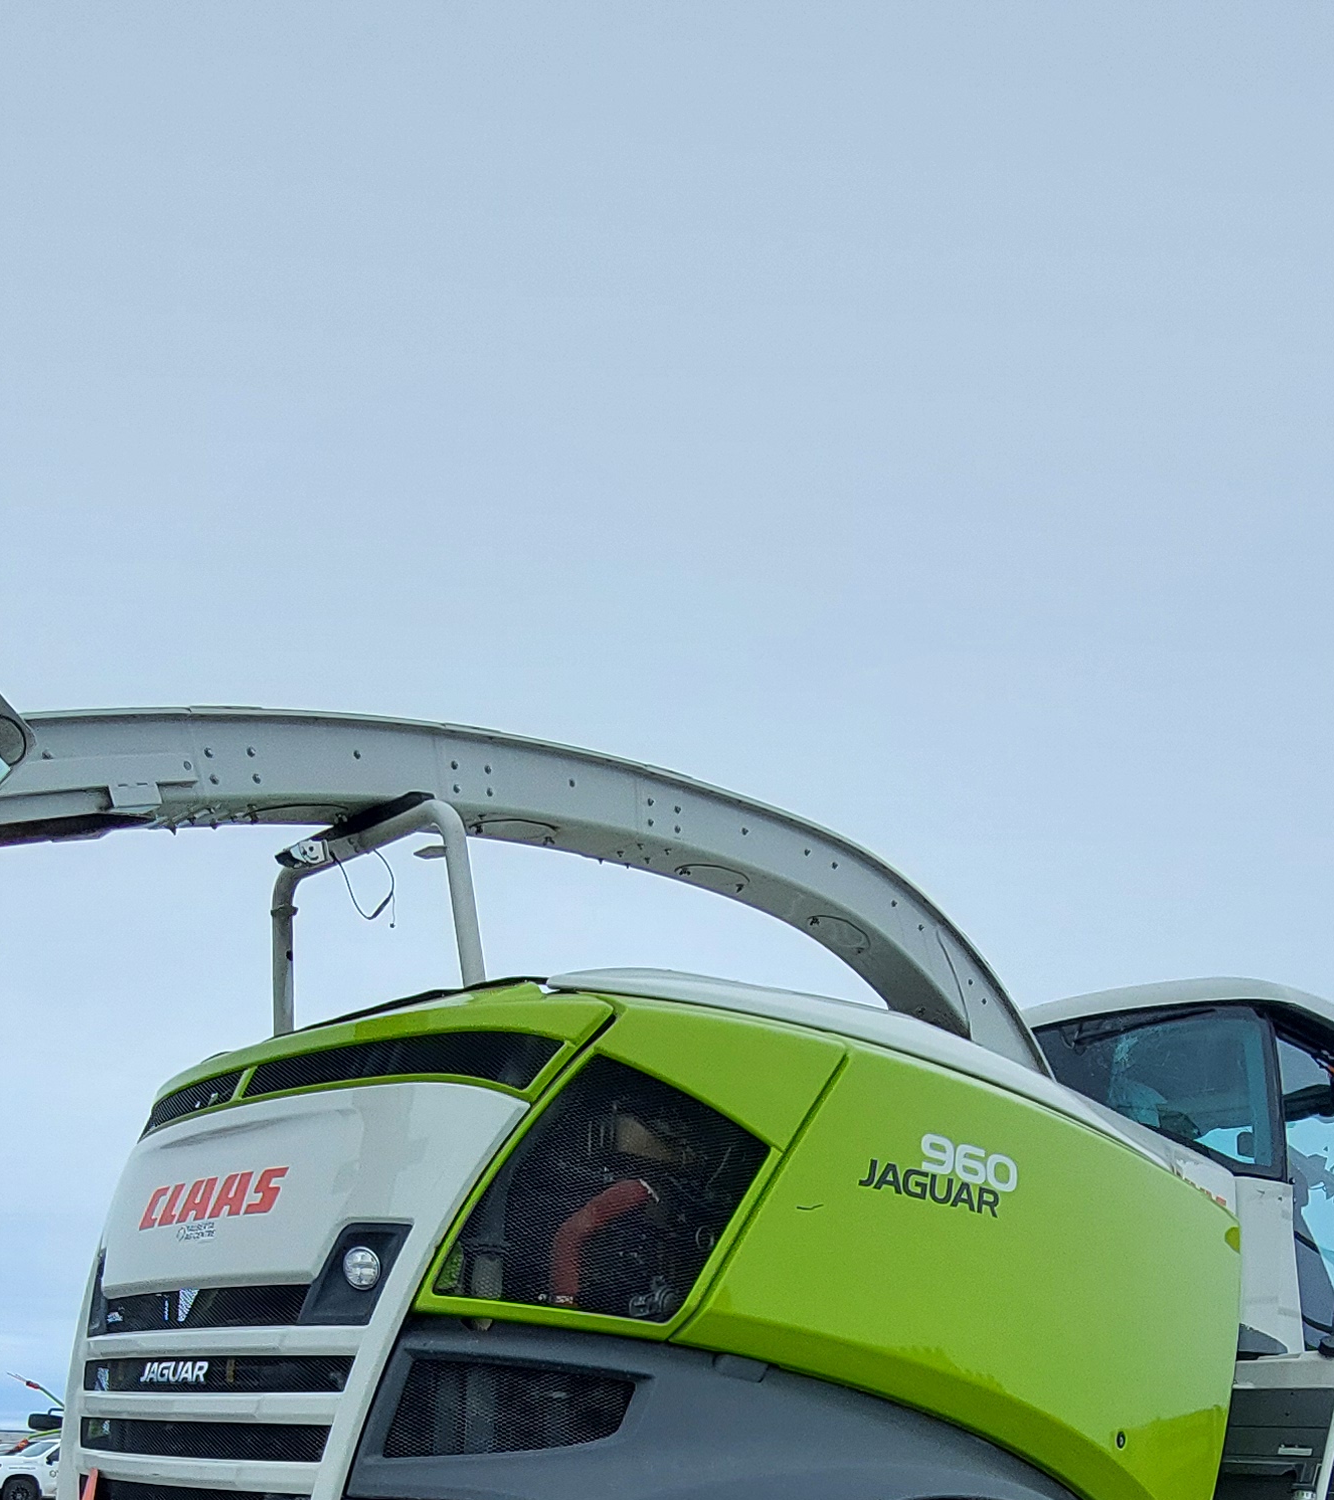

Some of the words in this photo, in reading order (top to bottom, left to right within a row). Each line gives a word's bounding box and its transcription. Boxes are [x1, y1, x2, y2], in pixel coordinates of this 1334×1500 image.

[858, 1158, 1001, 1219] JAGUAR
[920, 1133, 1018, 1192] 960
[138, 1166, 290, 1232] CLAAS
[140, 1361, 209, 1382] JAGUAR
